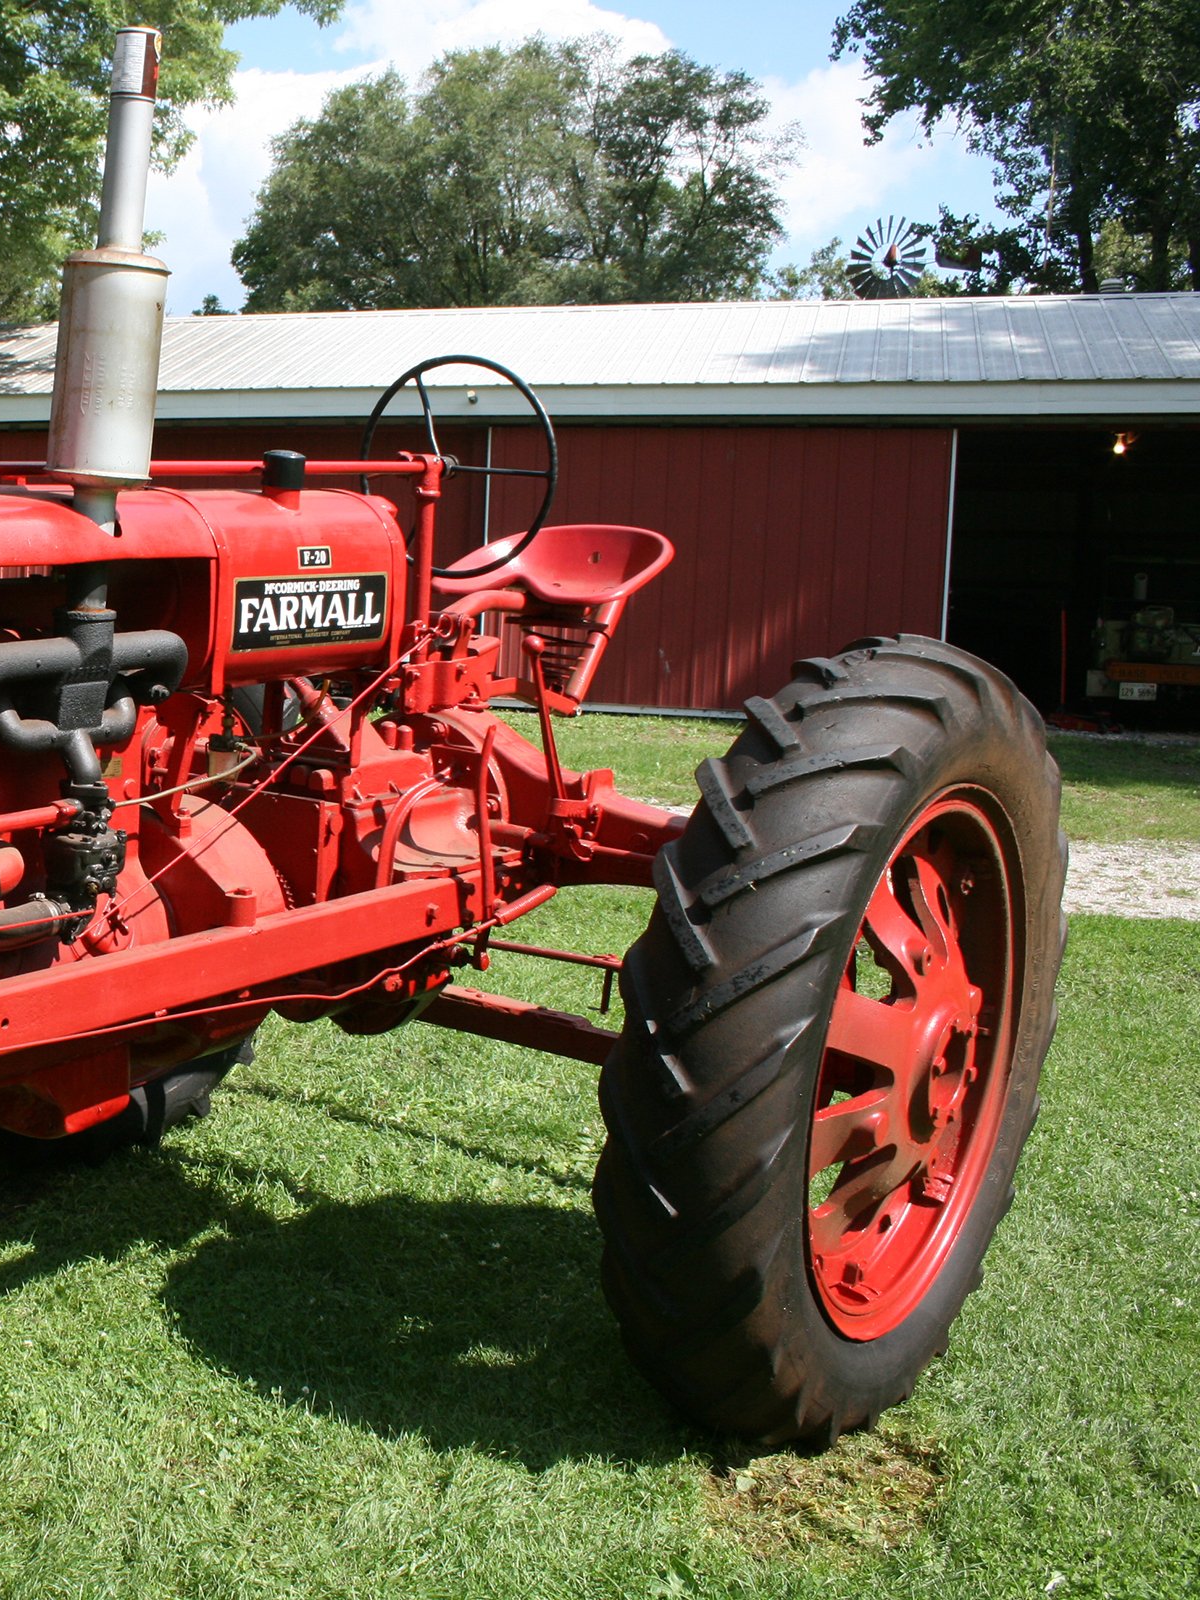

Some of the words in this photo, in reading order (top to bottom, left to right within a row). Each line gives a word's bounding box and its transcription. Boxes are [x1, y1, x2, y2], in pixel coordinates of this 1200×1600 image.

[303, 551, 326, 564] F-20
[239, 592, 380, 633] FARMALL
[270, 632, 303, 641] INTERNATIONAL
[330, 629, 351, 637] COMPANY
